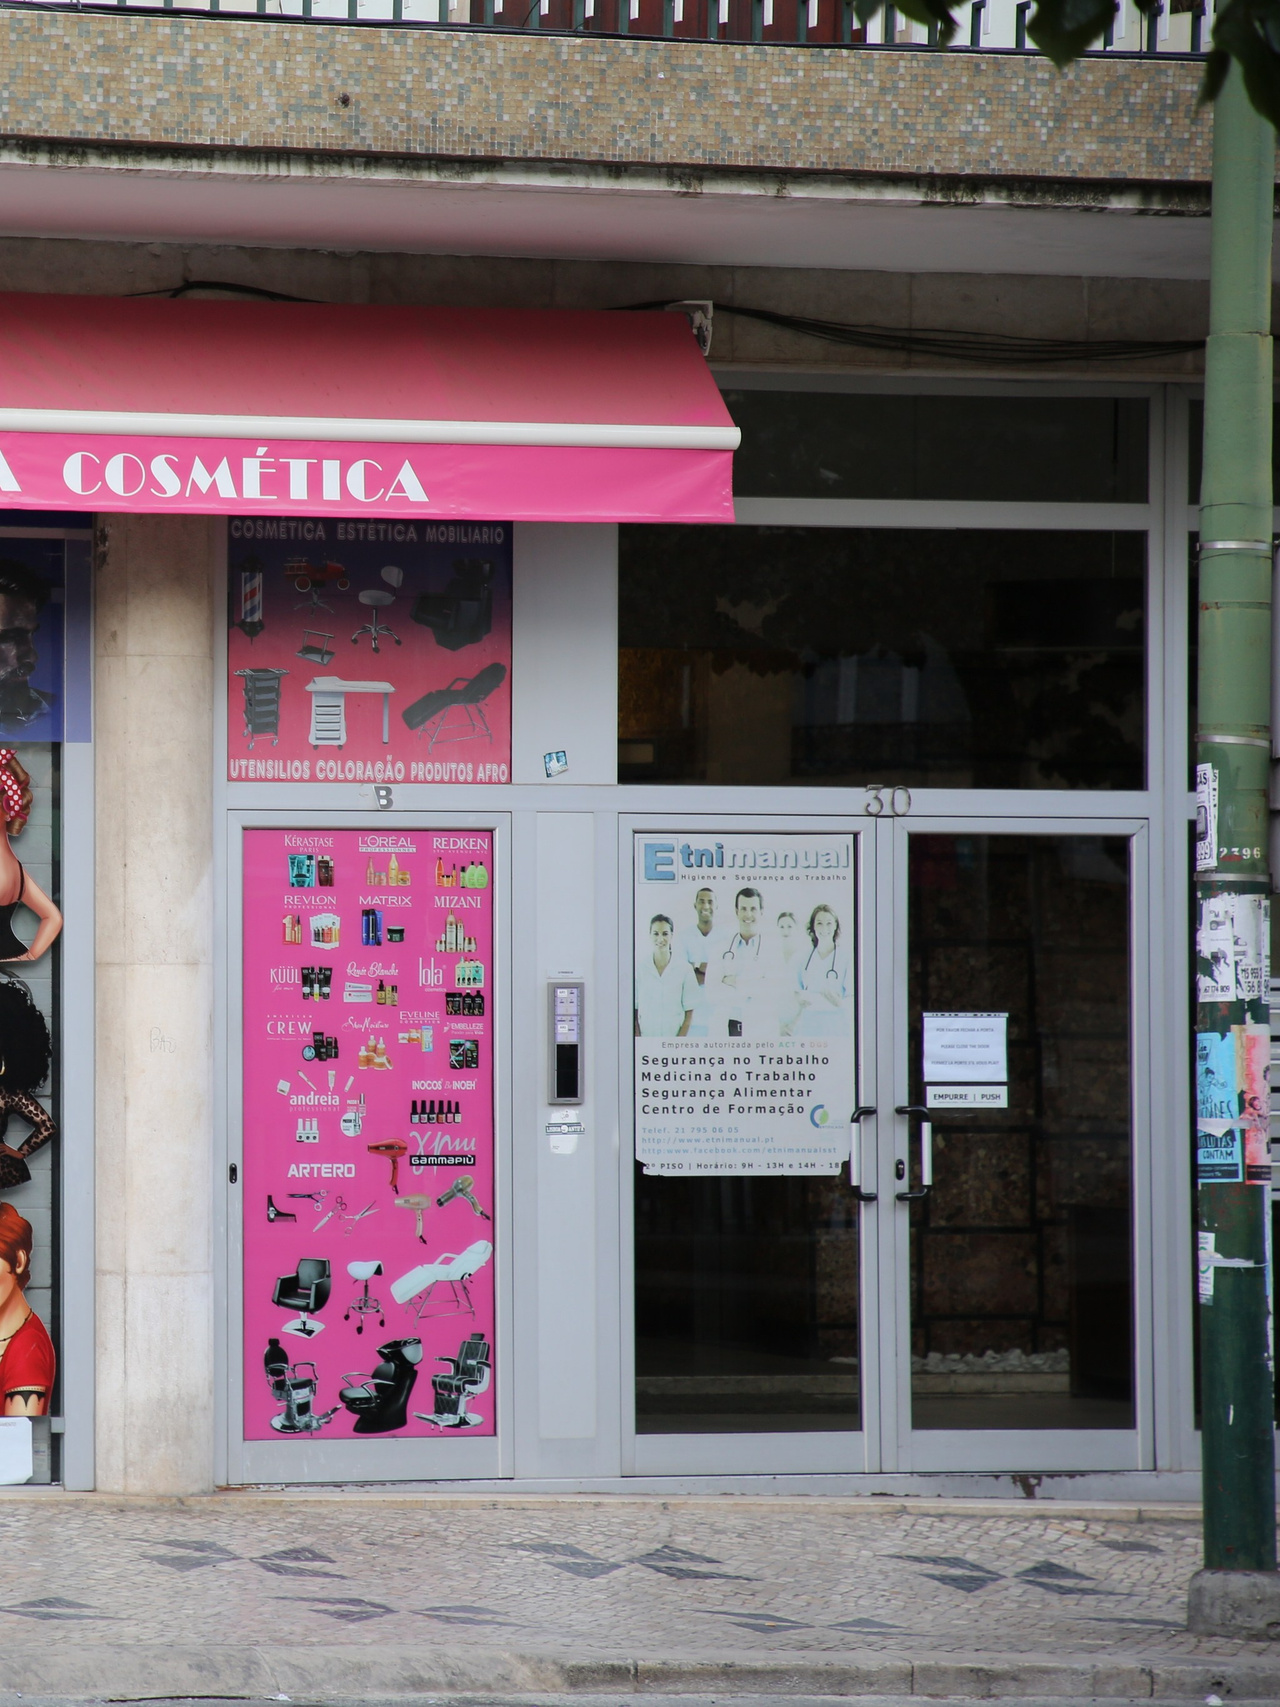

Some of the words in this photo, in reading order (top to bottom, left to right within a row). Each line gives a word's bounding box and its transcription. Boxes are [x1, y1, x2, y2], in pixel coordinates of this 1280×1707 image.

[62, 447, 430, 503] COSMÉTICA
[231, 516, 326, 541] COSMÉTICA
[336, 518, 418, 542] ESTÉTICA
[425, 525, 505, 545] MOBILIARIO
[229, 759, 311, 780] UTENSILIOS
[315, 755, 406, 783] COLORAÇÃO
[410, 762, 474, 782] PRODUTOS
[476, 763, 509, 783] AFRO
[372, 785, 394, 809] B
[865, 784, 911, 816] 30
[284, 834, 334, 848] KÉRASTASE
[433, 836, 488, 850] REDKEN
[644, 842, 850, 881] Etnimanual
[681, 873, 717, 882] Higiene
[734, 874, 784, 882] Segurança
[284, 895, 337, 905] REVLON
[359, 895, 412, 905] MATRIX
[433, 896, 482, 909] MIZANI
[270, 966, 301, 984] KÜÜL
[399, 1010, 440, 1020] EVELINE
[267, 1021, 312, 1035] CREW
[662, 1041, 701, 1050] Empresa
[703, 1041, 752, 1049] autorizada
[755, 1041, 774, 1050] pelo
[641, 1055, 725, 1068] Segurança
[733, 1056, 751, 1065] no
[758, 1054, 830, 1066] Trabalho
[641, 1070, 712, 1082] Medicina
[720, 1070, 738, 1082] do
[745, 1070, 816, 1082] Trabalho
[411, 1080, 443, 1090] INOCOS
[289, 1091, 340, 1105] andreia
[641, 1087, 725, 1100] Segurança
[733, 1086, 813, 1098] Alimentar
[933, 1093, 968, 1101] EMPURRE
[981, 1093, 1001, 1101] PUSH
[641, 1103, 695, 1115] Centro
[702, 1103, 721, 1115] de
[728, 1103, 805, 1117] Formação
[287, 1163, 356, 1178] ARTERO
[696, 1160, 738, 1169] Horário:
